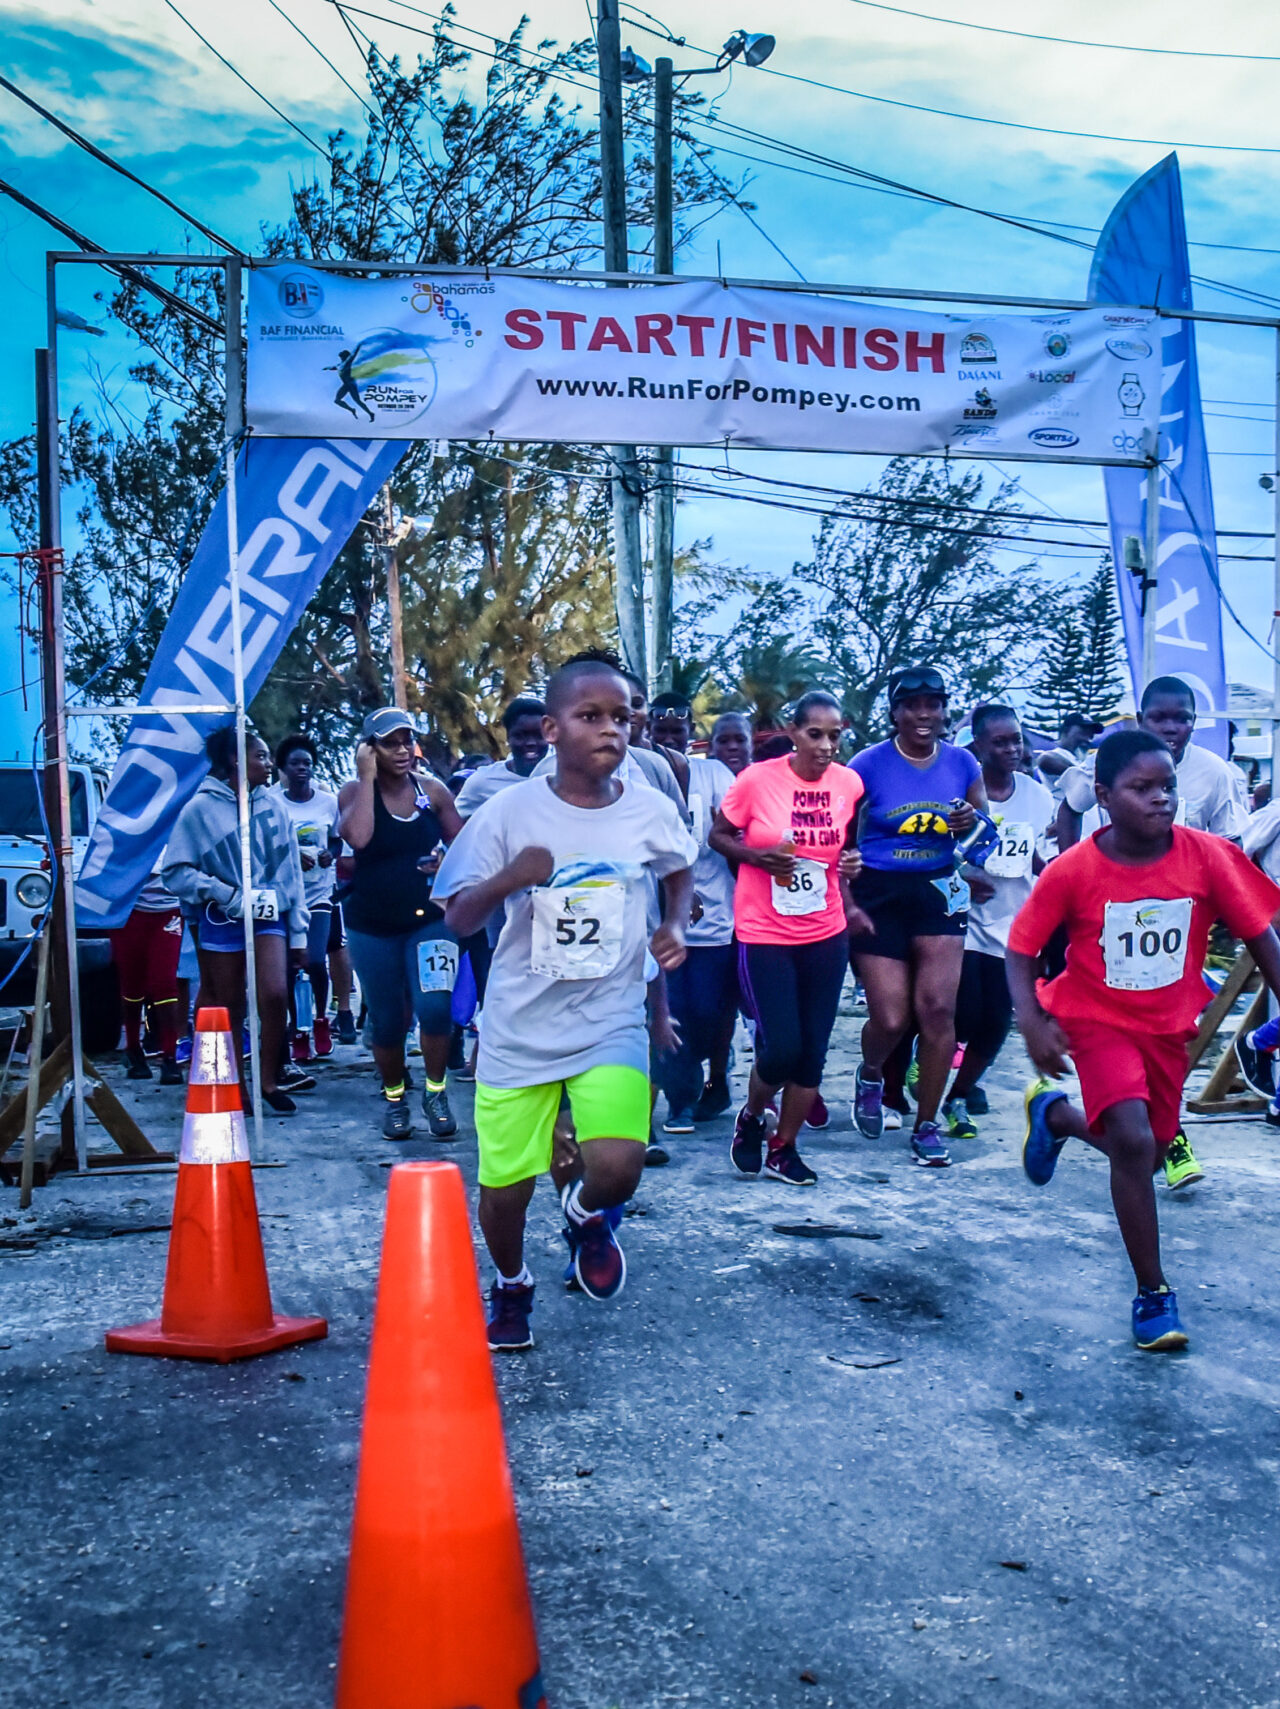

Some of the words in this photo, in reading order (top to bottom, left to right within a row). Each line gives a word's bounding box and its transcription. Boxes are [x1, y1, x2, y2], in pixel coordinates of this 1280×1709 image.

[432, 283, 495, 295] bahamas
[260, 325, 281, 336] BAF
[285, 325, 344, 336] FINANCIAL
[504, 308, 945, 374] START/FINISH
[364, 394, 427, 403] POMPEY
[366, 385, 398, 394] RUN
[536, 377, 921, 412] www.RunForPompey.com
[793, 790, 831, 808] POMPEY
[791, 811, 833, 828] RUNNING
[808, 830, 816, 846] A
[819, 828, 840, 847] CURE
[997, 839, 1029, 857] 124
[556, 918, 600, 946] 52
[1117, 927, 1182, 957] 100
[425, 955, 456, 974] 121
